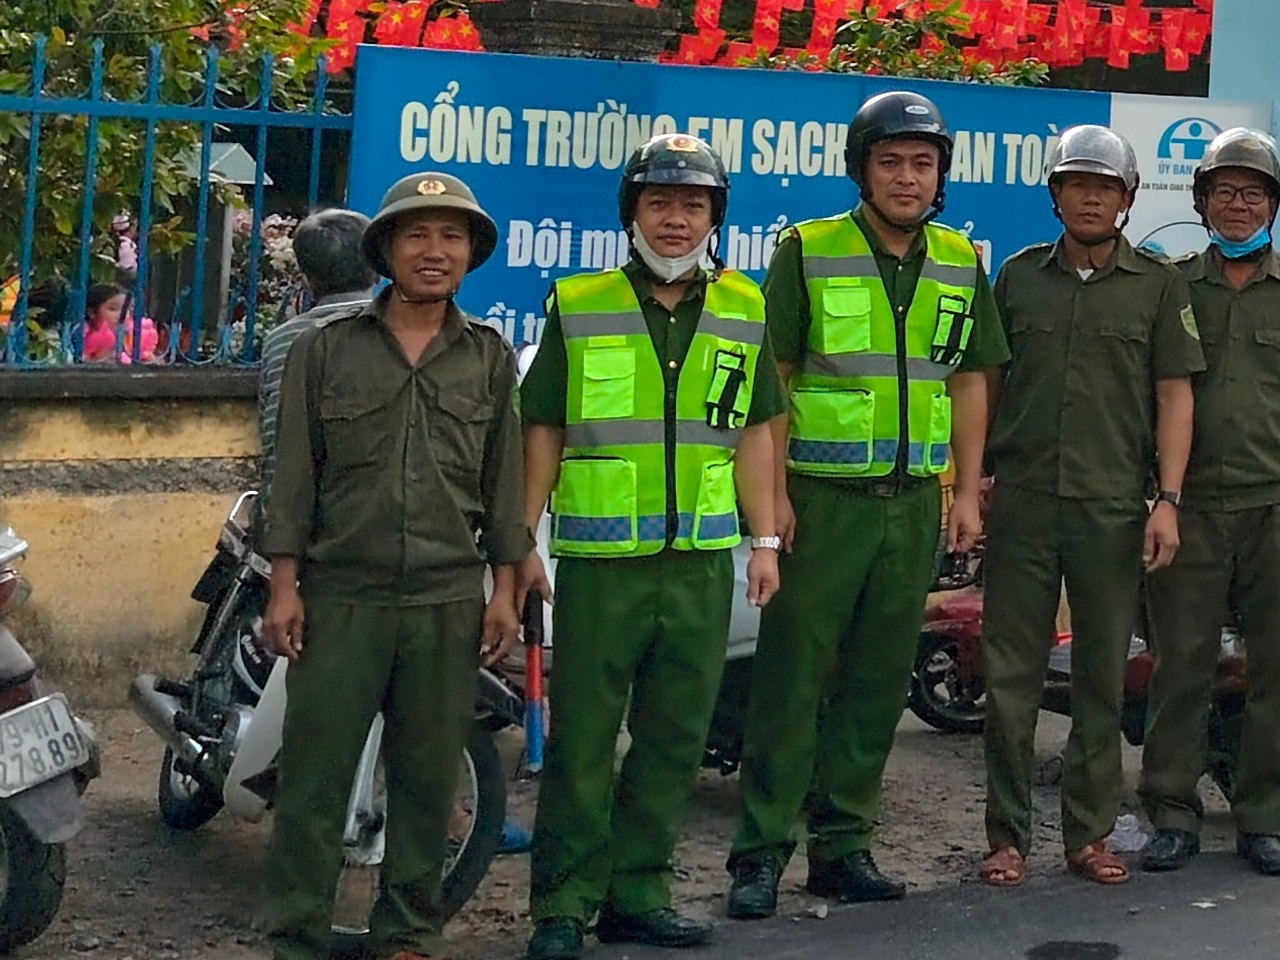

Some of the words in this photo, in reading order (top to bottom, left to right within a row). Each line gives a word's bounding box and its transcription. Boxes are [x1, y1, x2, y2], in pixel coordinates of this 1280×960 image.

[400, 80, 512, 165] CỔNG
[752, 118, 848, 187] SẠCH
[950, 130, 993, 184] AN
[507, 218, 573, 278] Đội
